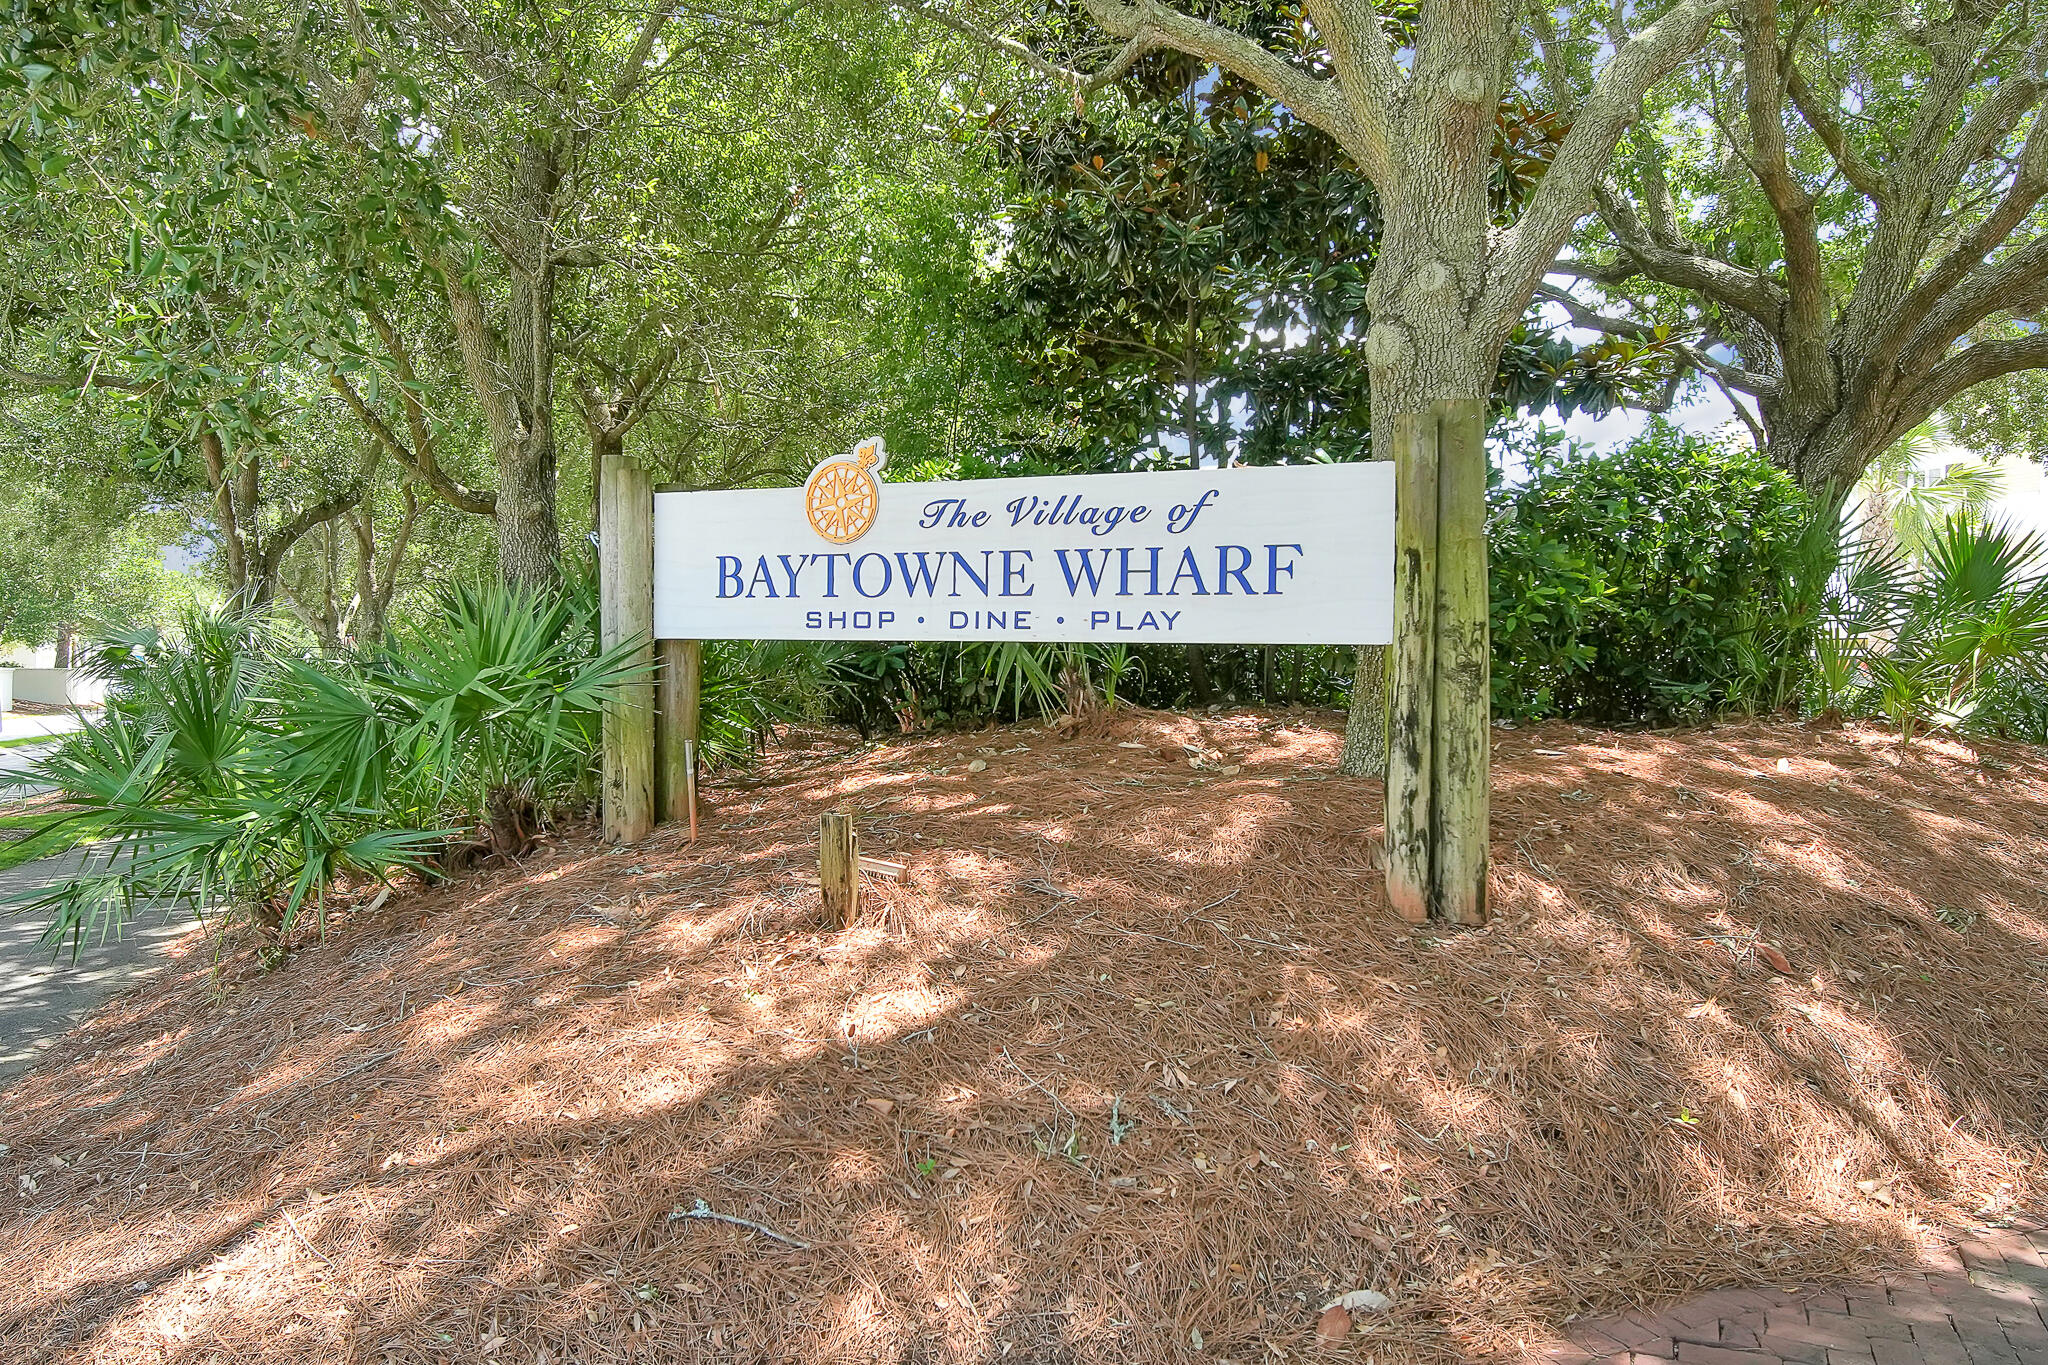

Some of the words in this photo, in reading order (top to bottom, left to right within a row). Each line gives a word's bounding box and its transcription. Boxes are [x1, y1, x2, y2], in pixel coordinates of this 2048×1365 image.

[918, 498, 991, 529] The
[1005, 494, 1151, 536] Village
[1166, 489, 1221, 534] of
[716, 550, 1035, 599] BAYTOWNE
[1054, 543, 1305, 597] WHARF
[805, 610, 896, 630] SHOP
[949, 610, 1032, 630] DINE
[1090, 610, 1182, 631] PLAY
